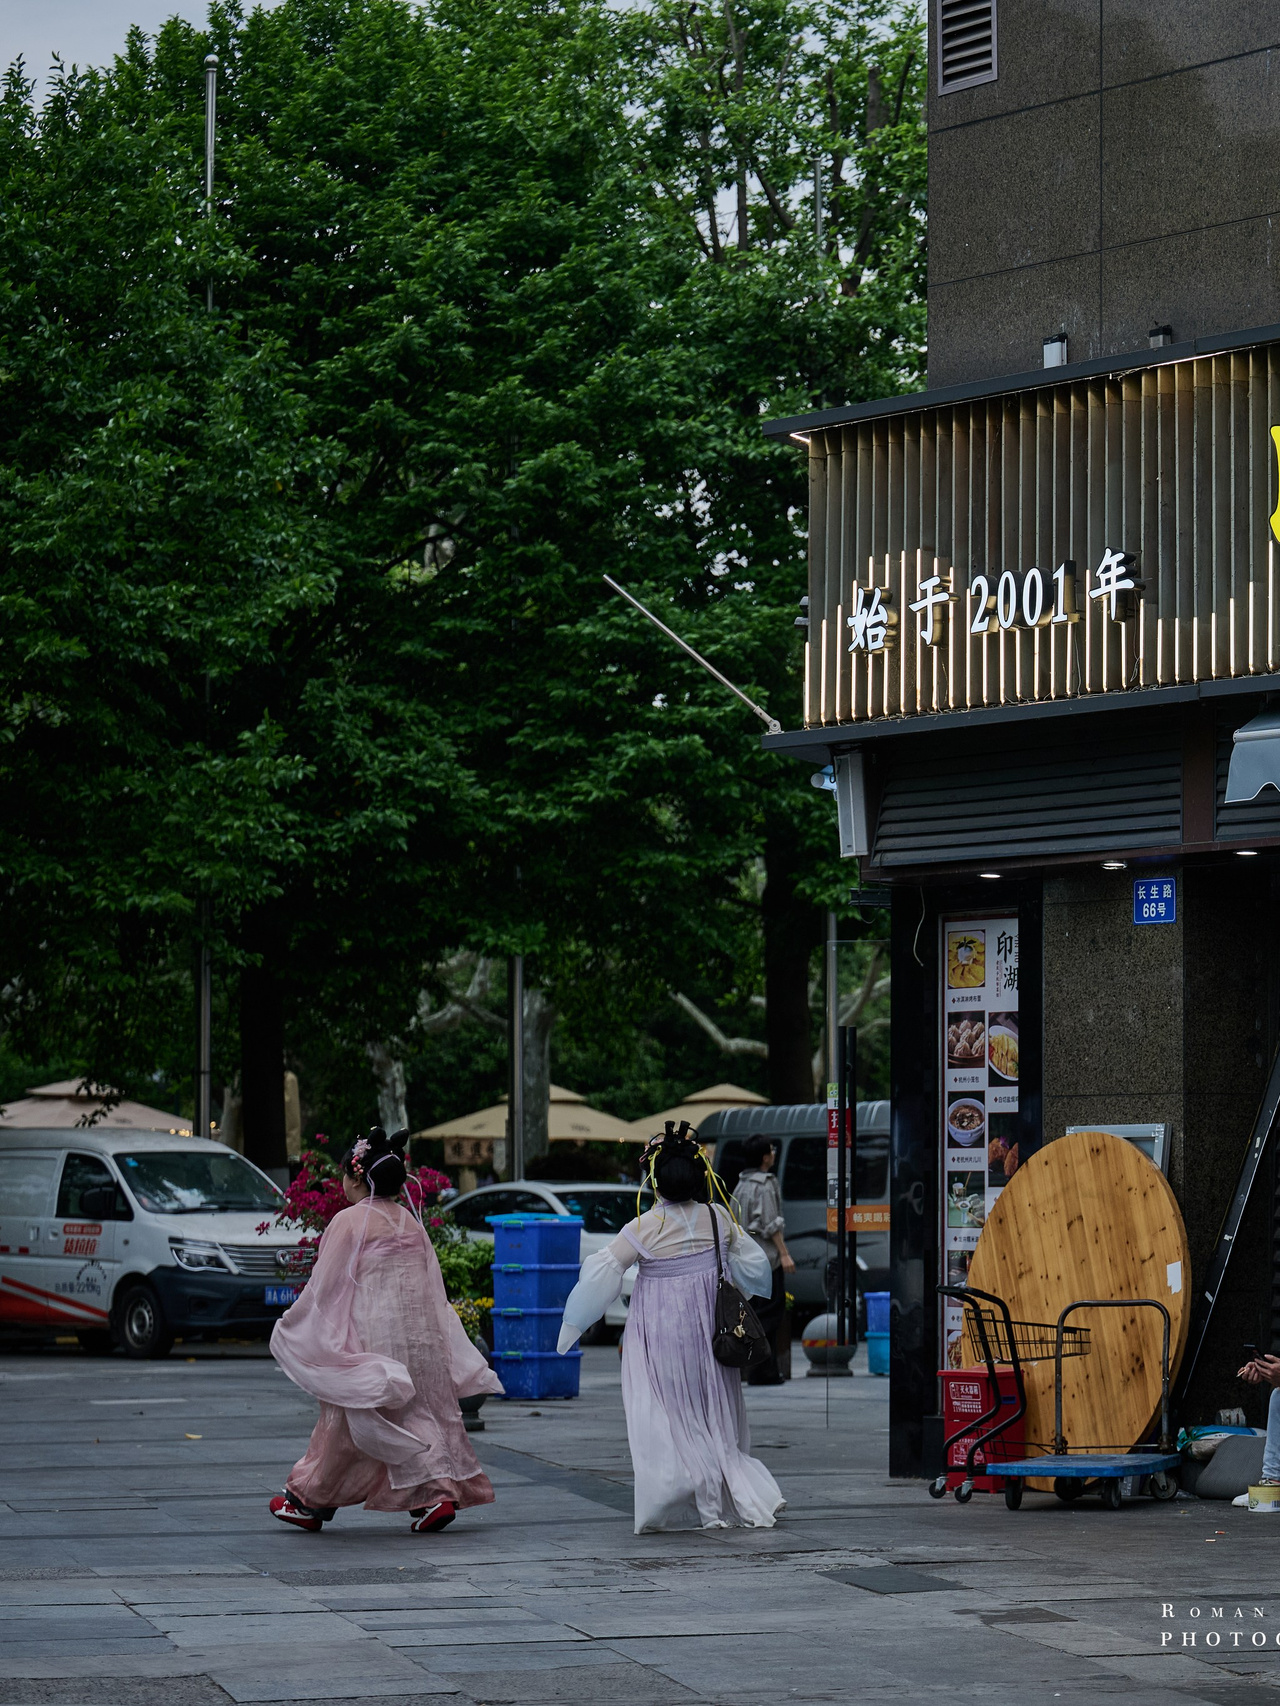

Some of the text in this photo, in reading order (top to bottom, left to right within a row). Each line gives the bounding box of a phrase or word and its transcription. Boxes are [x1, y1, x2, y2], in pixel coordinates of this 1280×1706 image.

[847, 548, 1135, 653] 始于2001年
[1137, 883, 1173, 900] 长生路
[1142, 902, 1167, 918] 66号
[997, 930, 1019, 992] 印湖
[958, 1076, 980, 1084] 杭州小笼包
[266, 1287, 301, 1304] A6H
